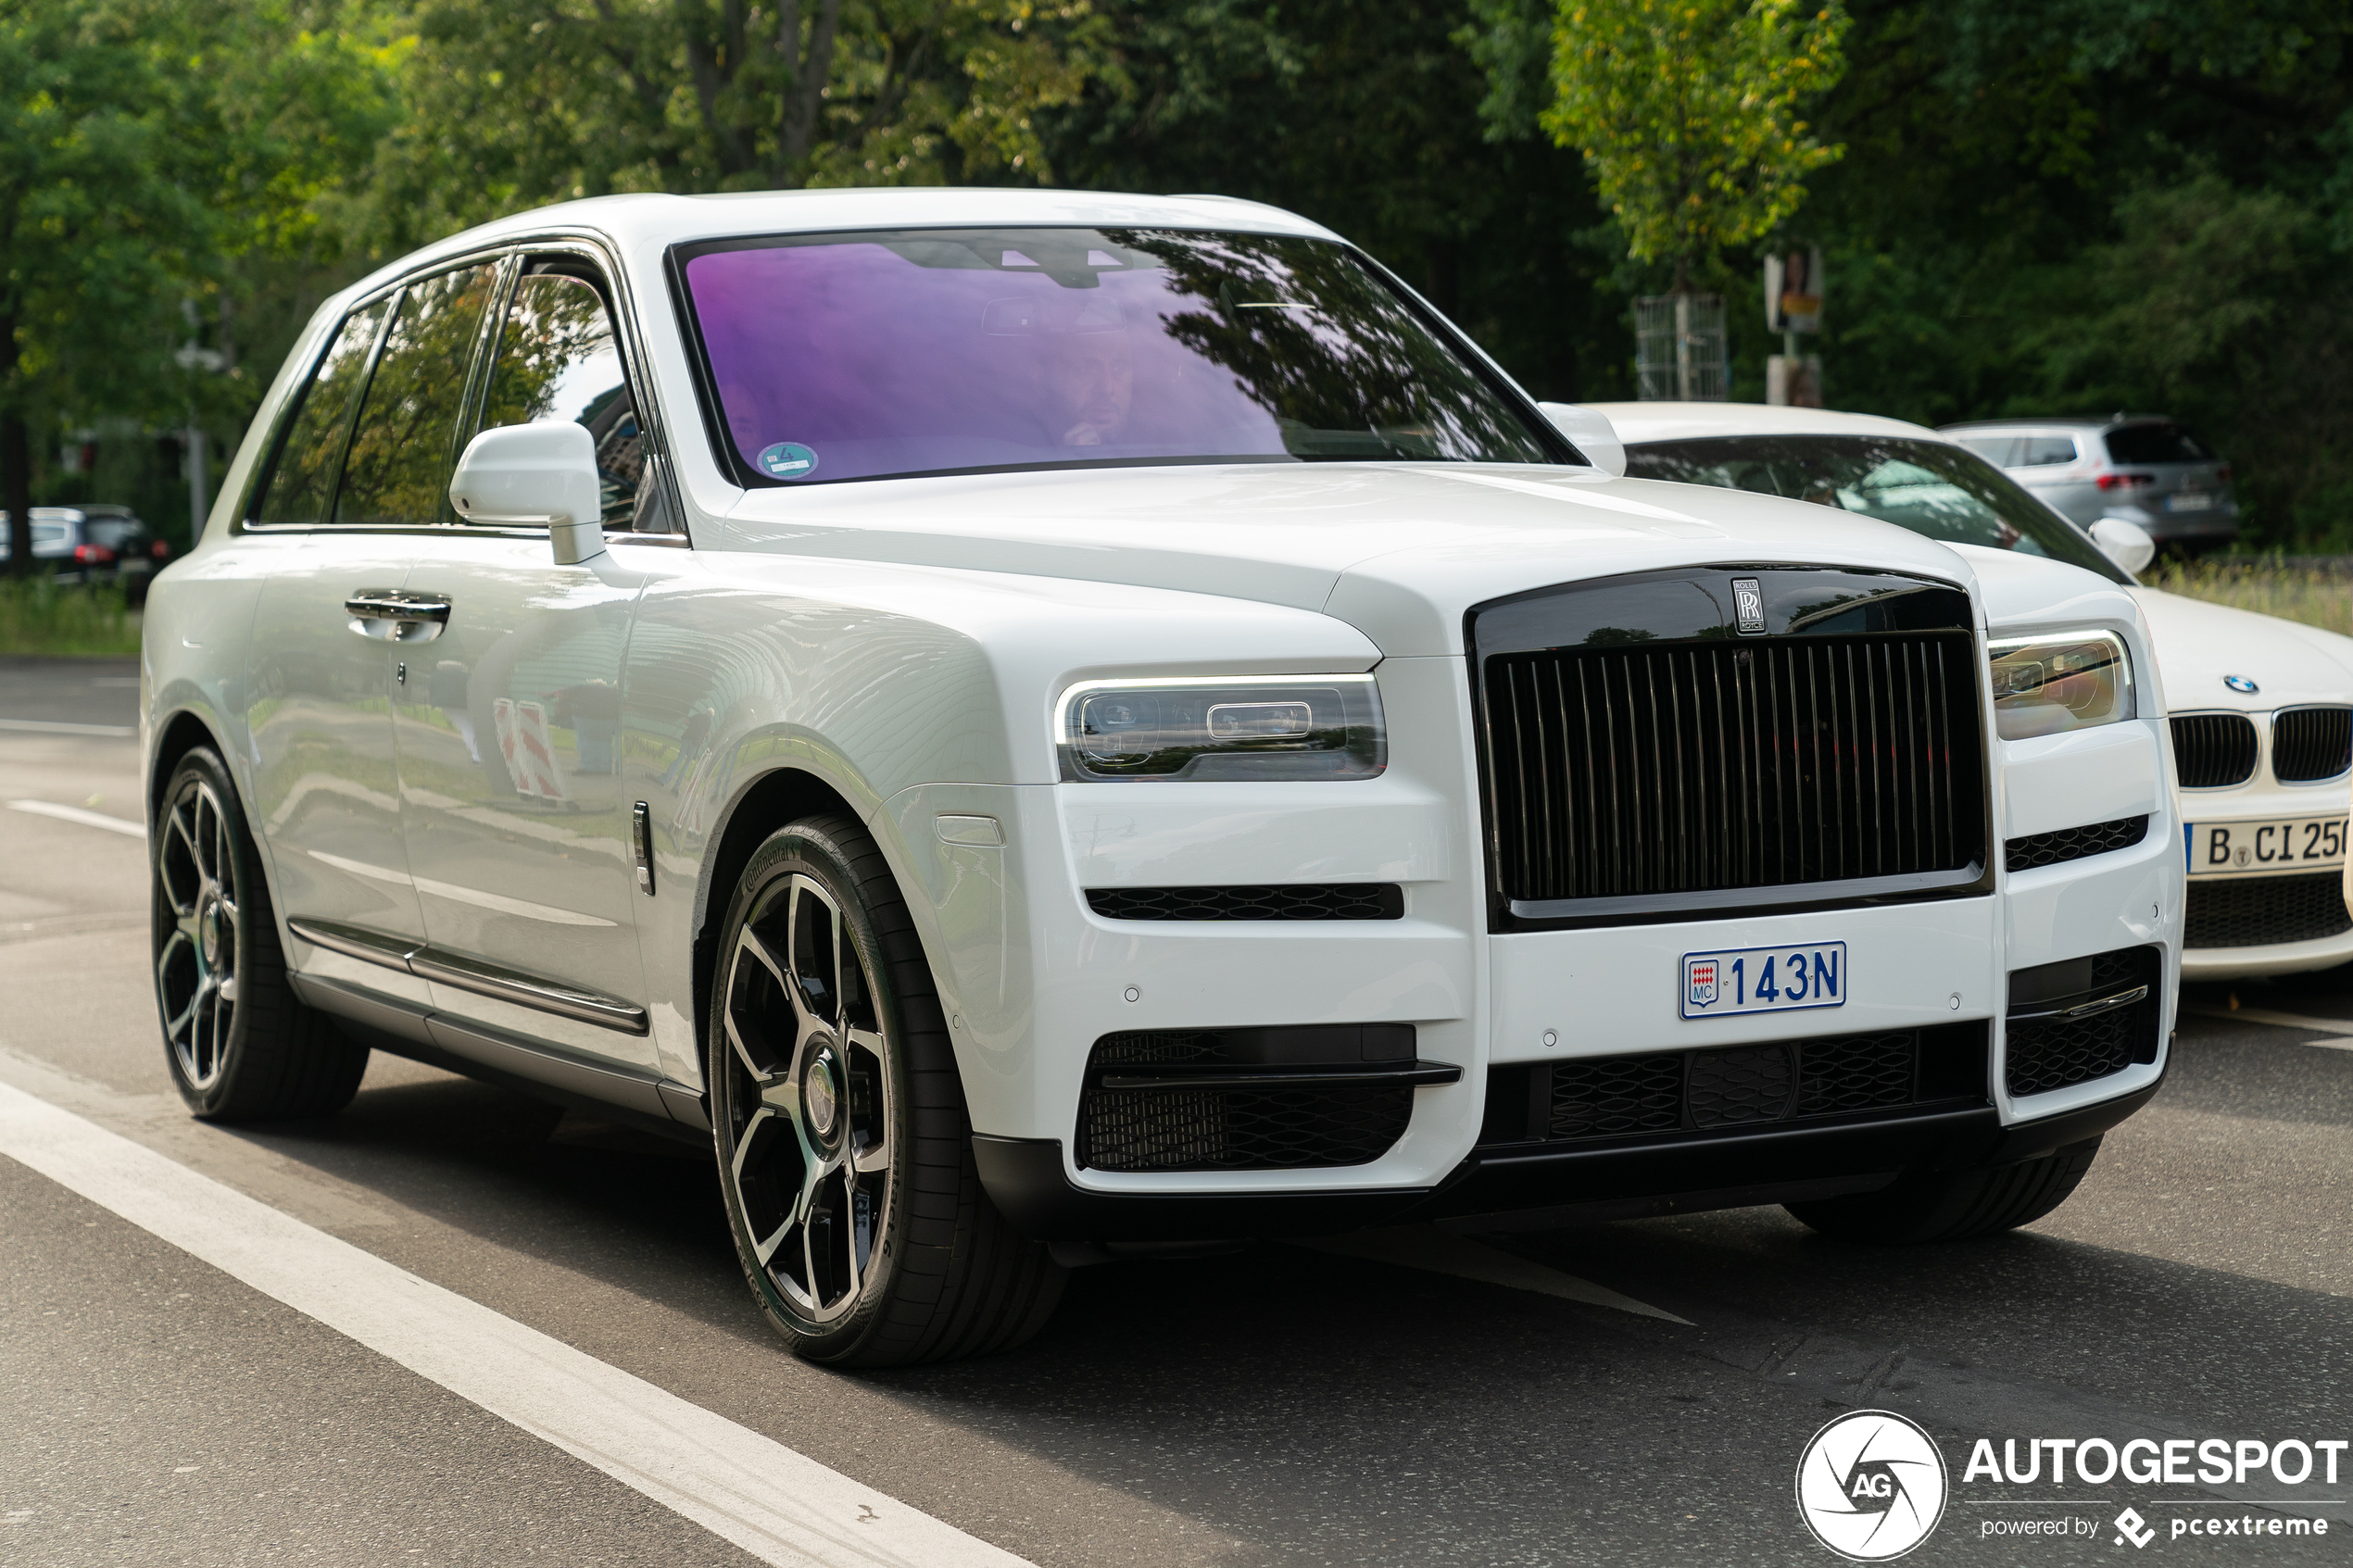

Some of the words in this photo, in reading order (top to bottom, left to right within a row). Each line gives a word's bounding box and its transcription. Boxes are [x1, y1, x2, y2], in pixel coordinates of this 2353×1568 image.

[779, 447, 794, 460] 4
[1735, 582, 1757, 590] ROLLS
[1739, 591, 1761, 620] RR
[1742, 621, 1763, 629] ROYCE
[2208, 828, 2231, 865] B
[2256, 825, 2294, 862] CI
[745, 843, 790, 893] Continental
[1731, 949, 1838, 1005] 143N
[1693, 985, 1712, 1000] MC
[883, 1239, 892, 1258] 6
